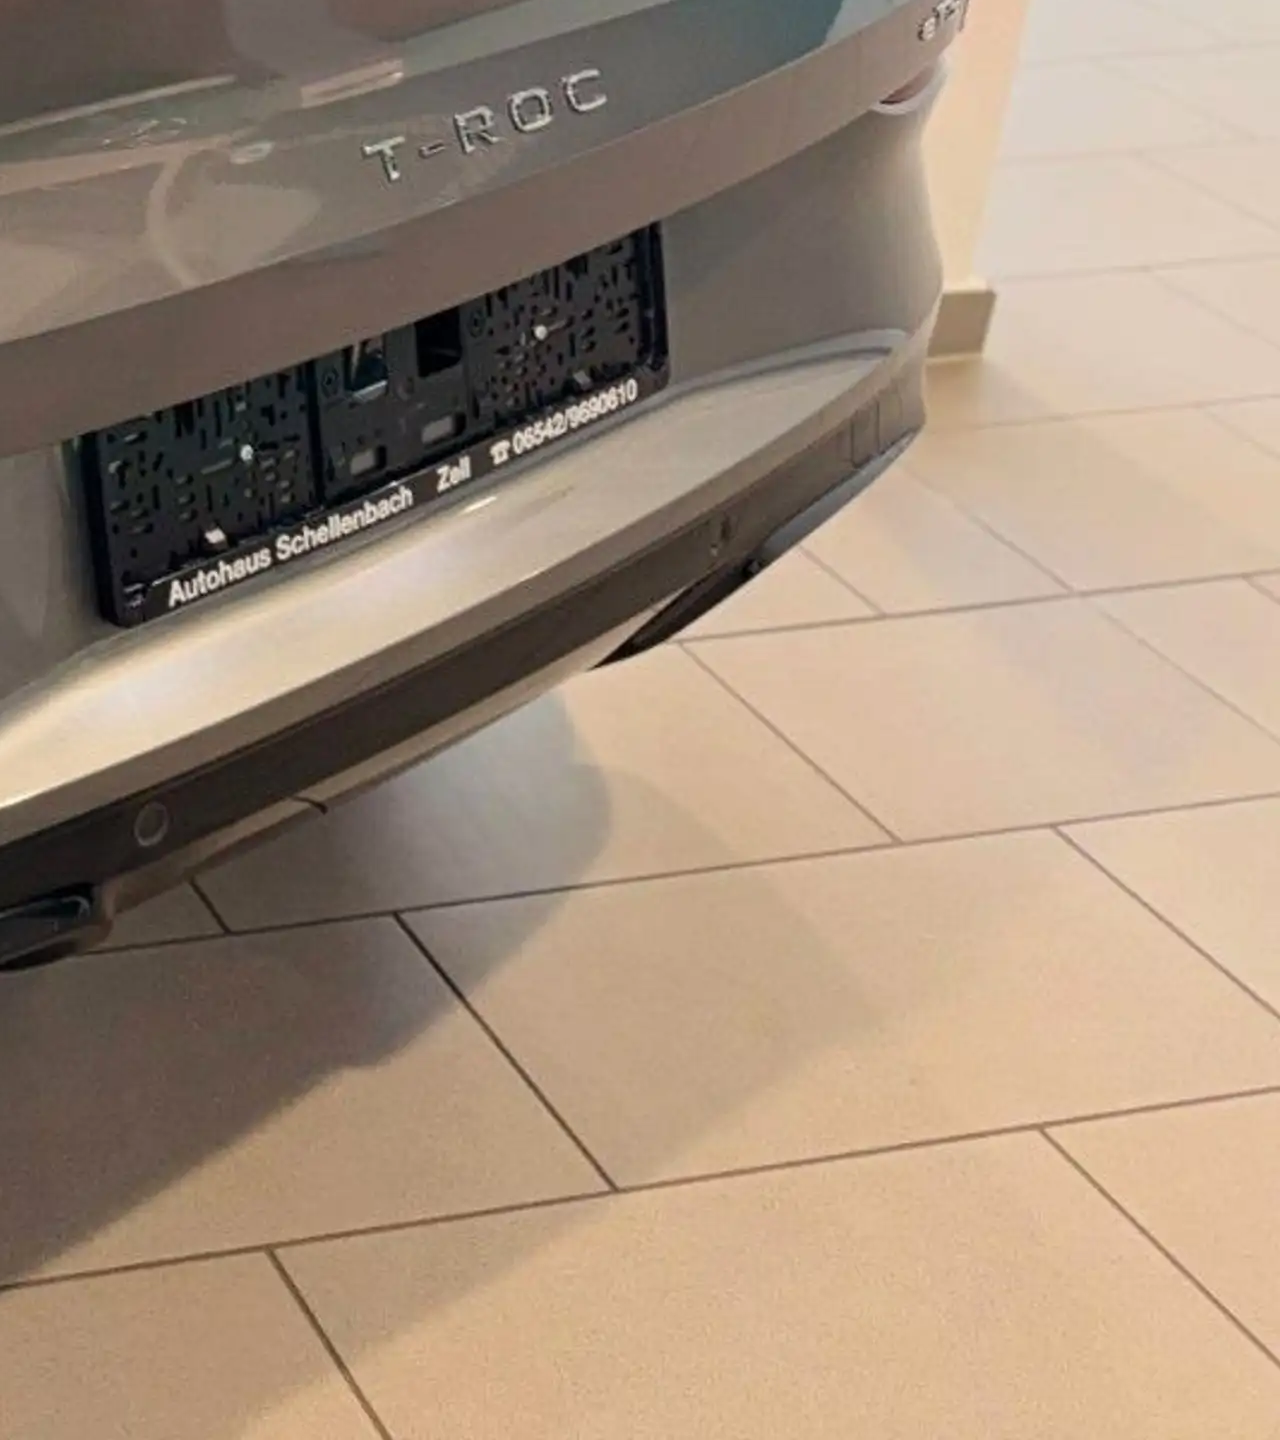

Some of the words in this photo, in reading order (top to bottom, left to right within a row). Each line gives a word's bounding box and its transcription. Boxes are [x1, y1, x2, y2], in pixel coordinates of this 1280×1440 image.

[361, 69, 607, 181] T-ROC
[168, 547, 272, 608] Autohaus
[275, 485, 414, 560] Schellenbach
[437, 455, 472, 493] Zell
